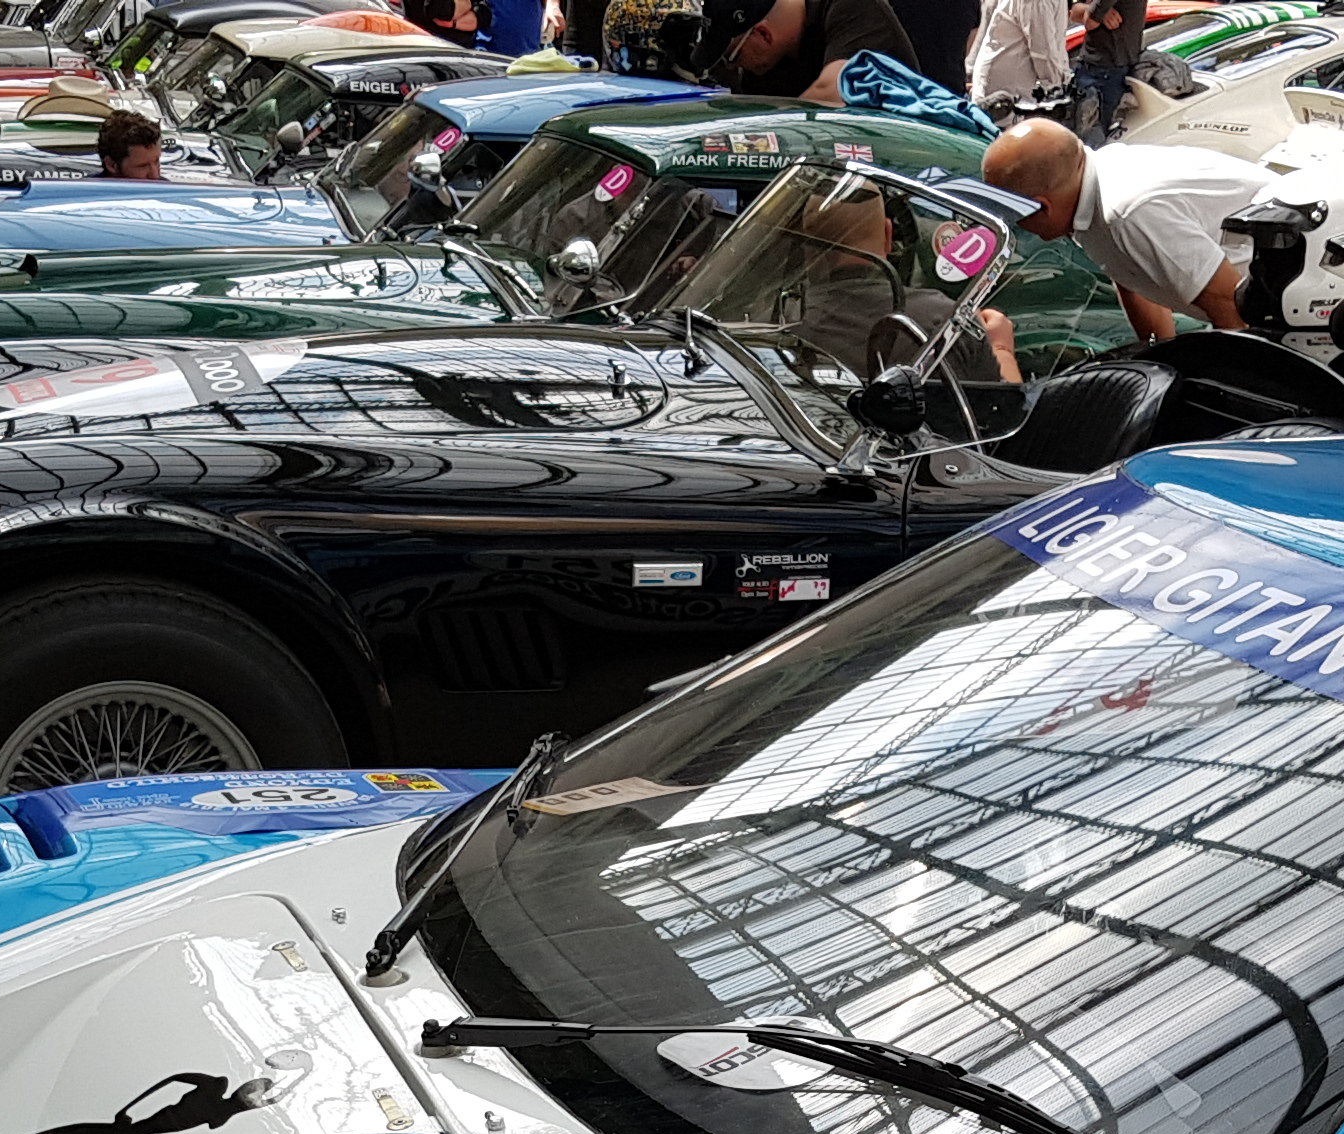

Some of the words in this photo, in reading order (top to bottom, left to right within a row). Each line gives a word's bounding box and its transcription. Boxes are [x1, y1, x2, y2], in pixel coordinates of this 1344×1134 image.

[349, 80, 400, 95] ENGEL
[672, 154, 719, 166] MARK
[727, 155, 797, 168] FREEMA
[605, 170, 628, 190] D
[950, 232, 987, 264] D
[1017, 497, 1189, 595] LIGIER
[752, 553, 829, 565] REBELLION
[221, 788, 337, 805] 251
